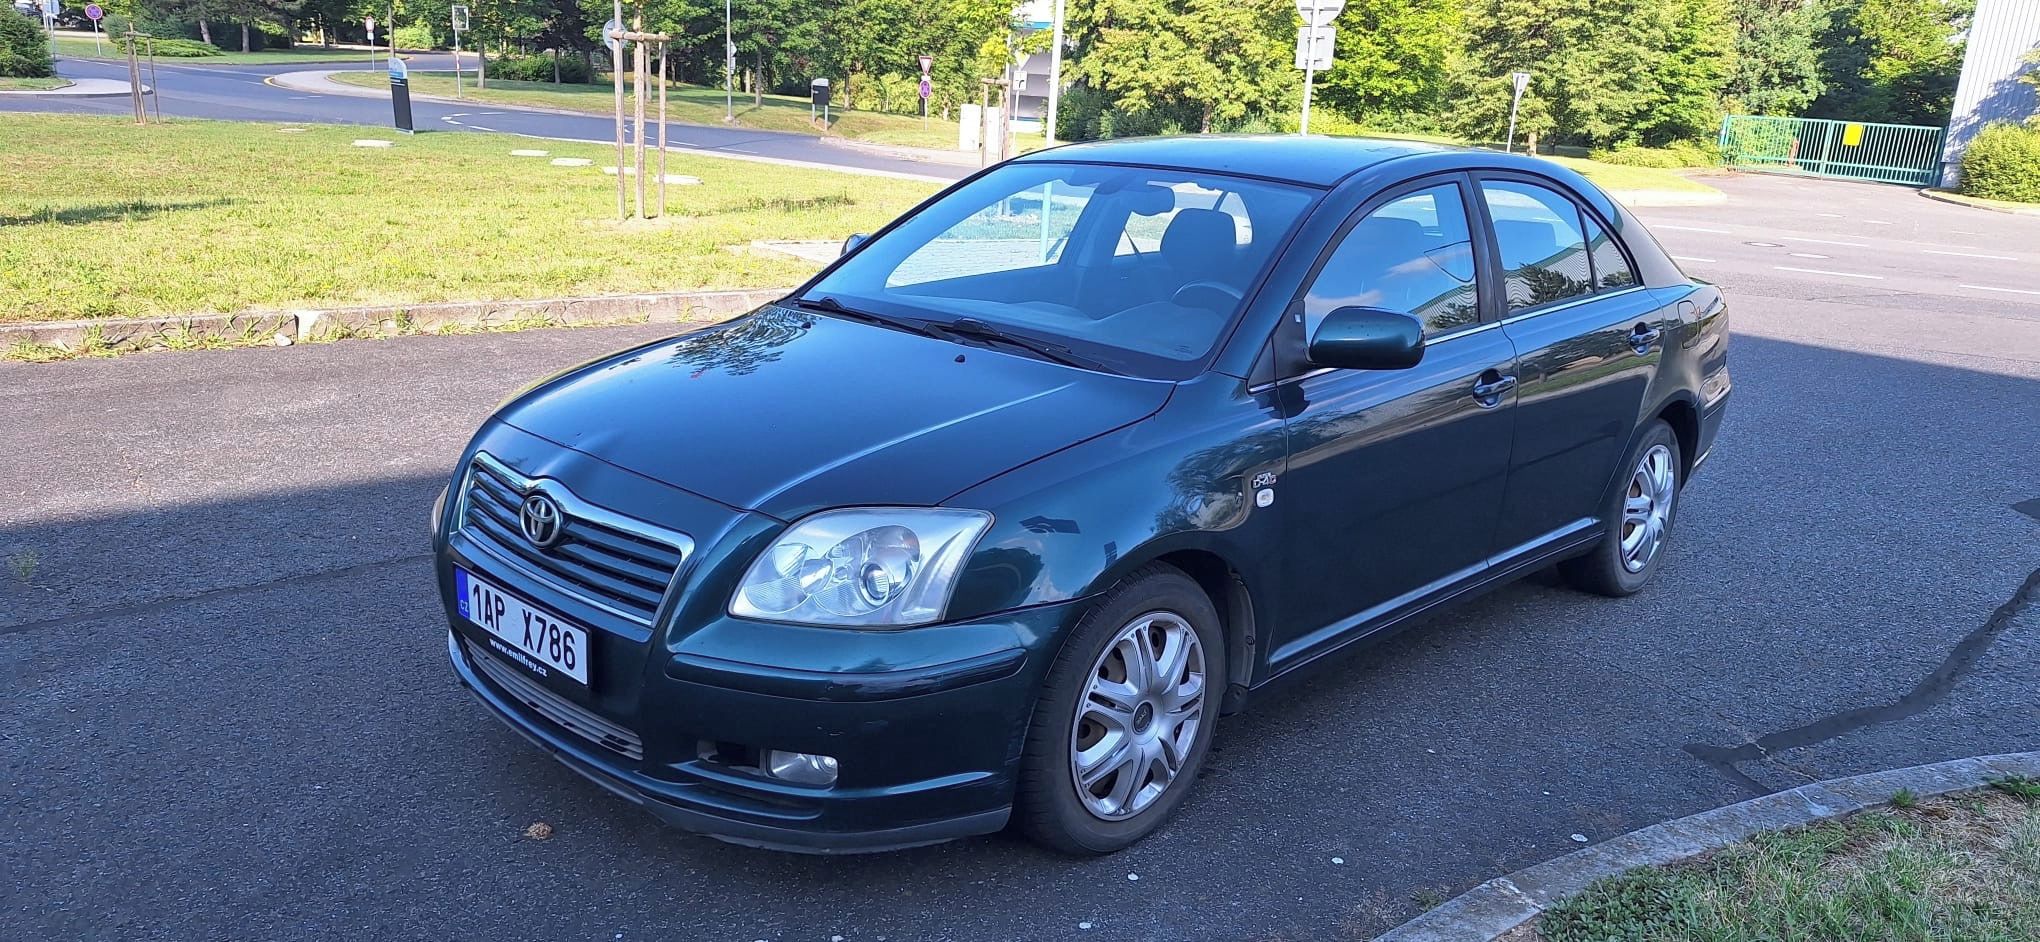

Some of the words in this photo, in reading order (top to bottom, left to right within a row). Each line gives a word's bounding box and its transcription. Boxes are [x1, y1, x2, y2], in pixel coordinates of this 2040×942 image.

[460, 600, 469, 613] CZ
[473, 584, 505, 632] 1AP
[522, 608, 576, 671] X786
[489, 638, 548, 677] www.emilfrey.cz
